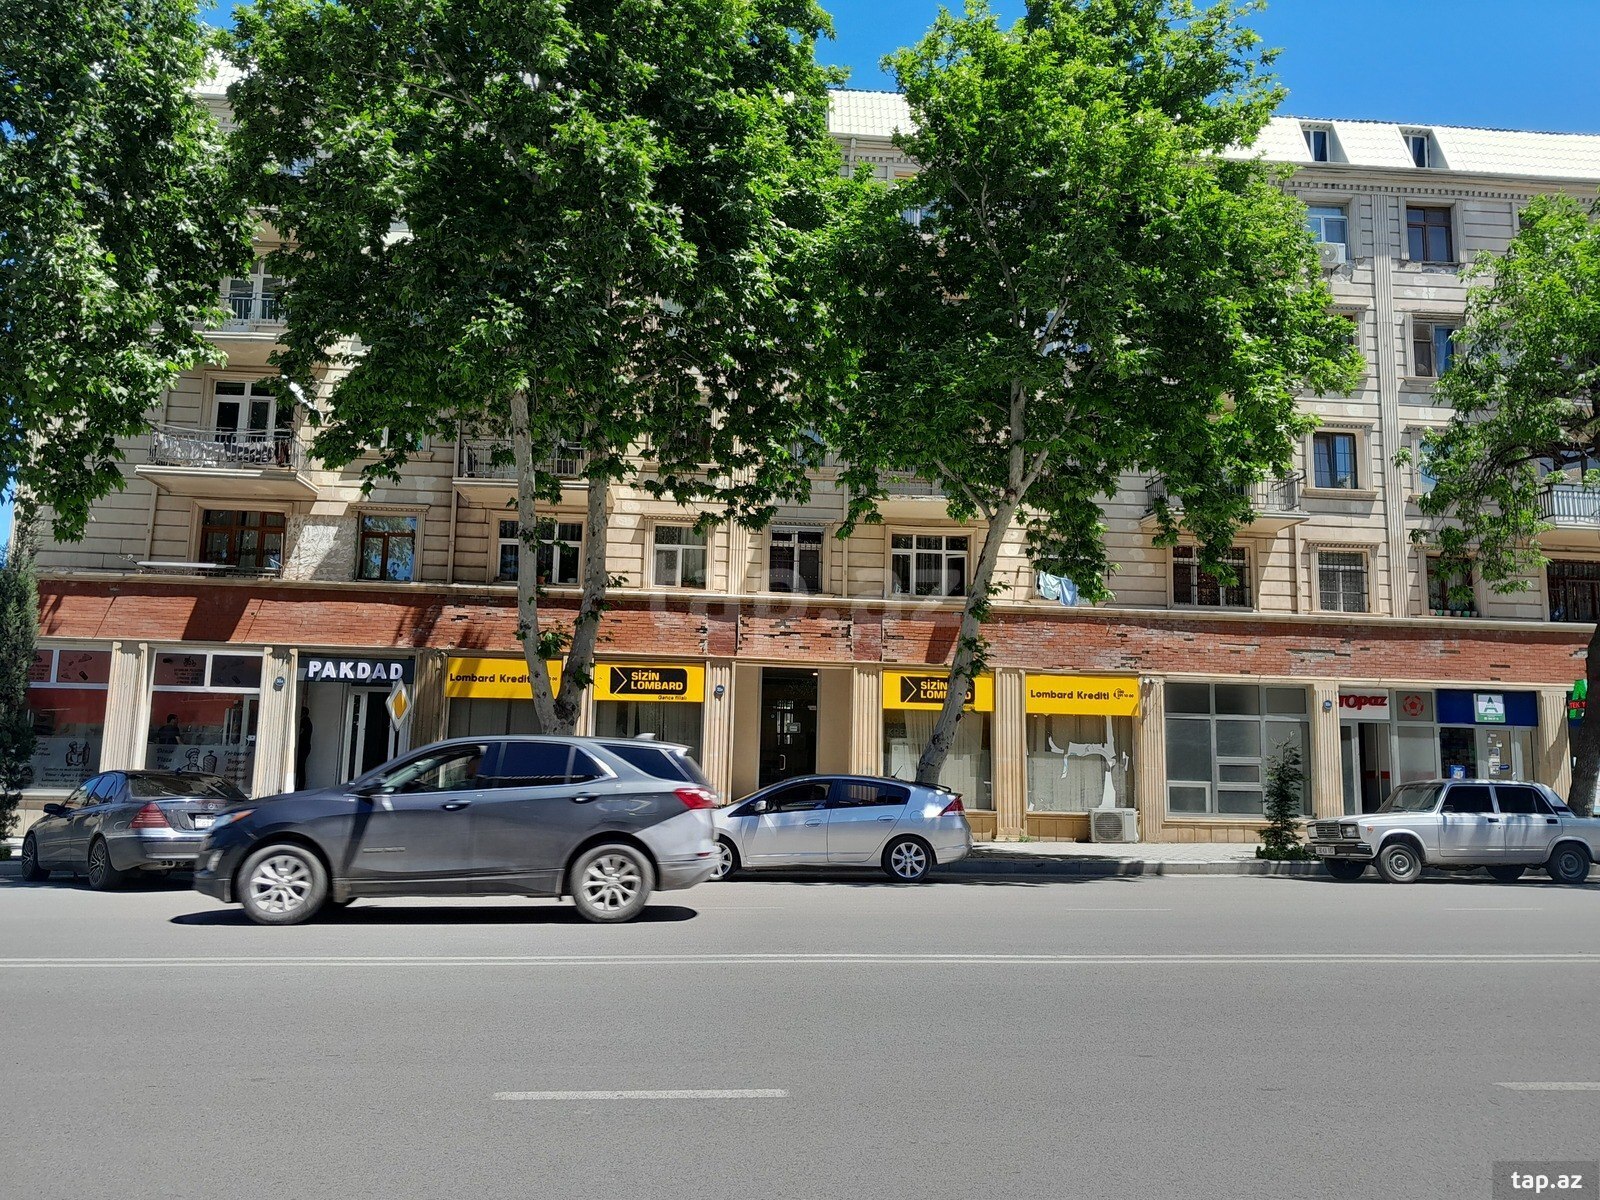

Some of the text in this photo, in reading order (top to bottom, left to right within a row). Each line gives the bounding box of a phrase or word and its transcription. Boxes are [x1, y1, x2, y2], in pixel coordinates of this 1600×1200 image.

[308, 660, 403, 680] PAKDAD
[449, 673, 531, 683] Lombard Kredit
[631, 681, 684, 691] LOMBARD
[920, 690, 972, 700] LOMD
[1030, 689, 1074, 699] Lombard
[1077, 690, 1110, 700] Krediti
